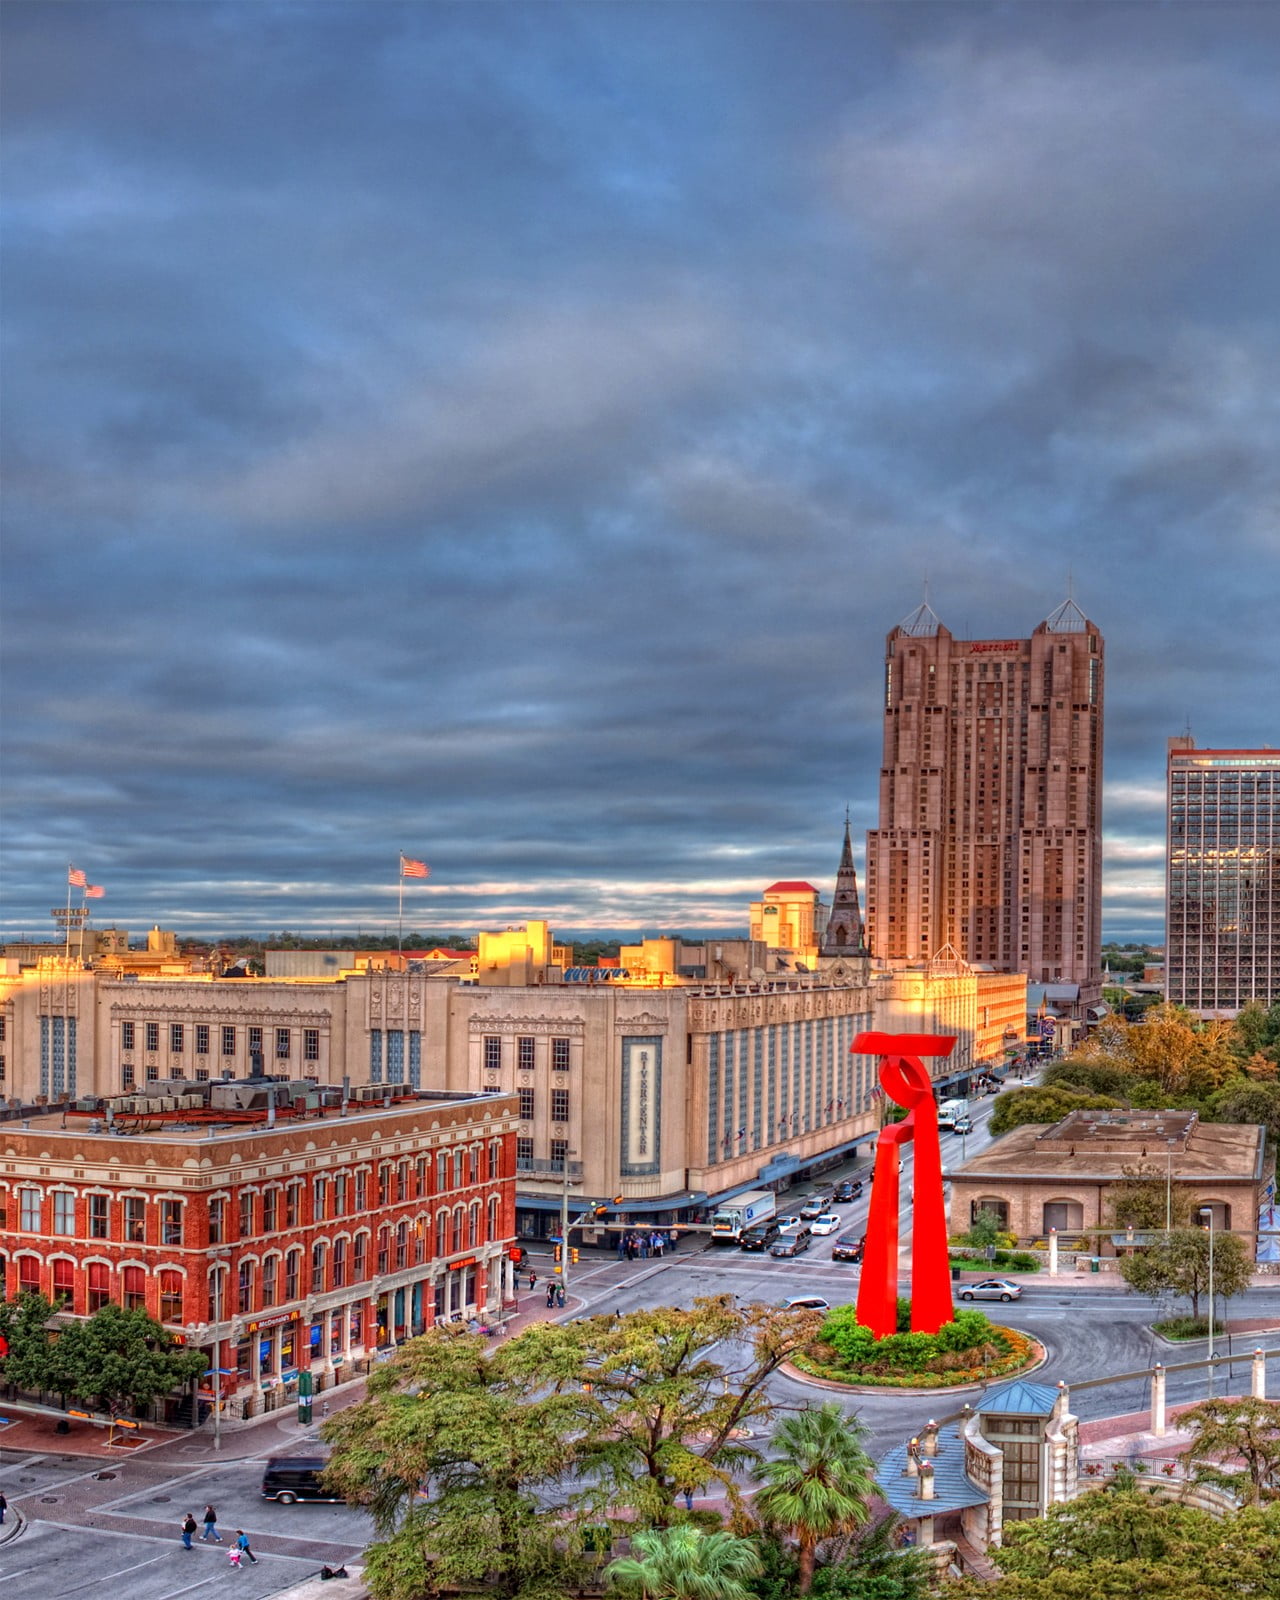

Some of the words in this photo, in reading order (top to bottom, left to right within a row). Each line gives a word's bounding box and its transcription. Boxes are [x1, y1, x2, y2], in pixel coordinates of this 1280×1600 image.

[970, 641, 1019, 653] Marriott
[640, 1051, 648, 1155] RIVERCENTER
[258, 1314, 290, 1329] McDonald's
